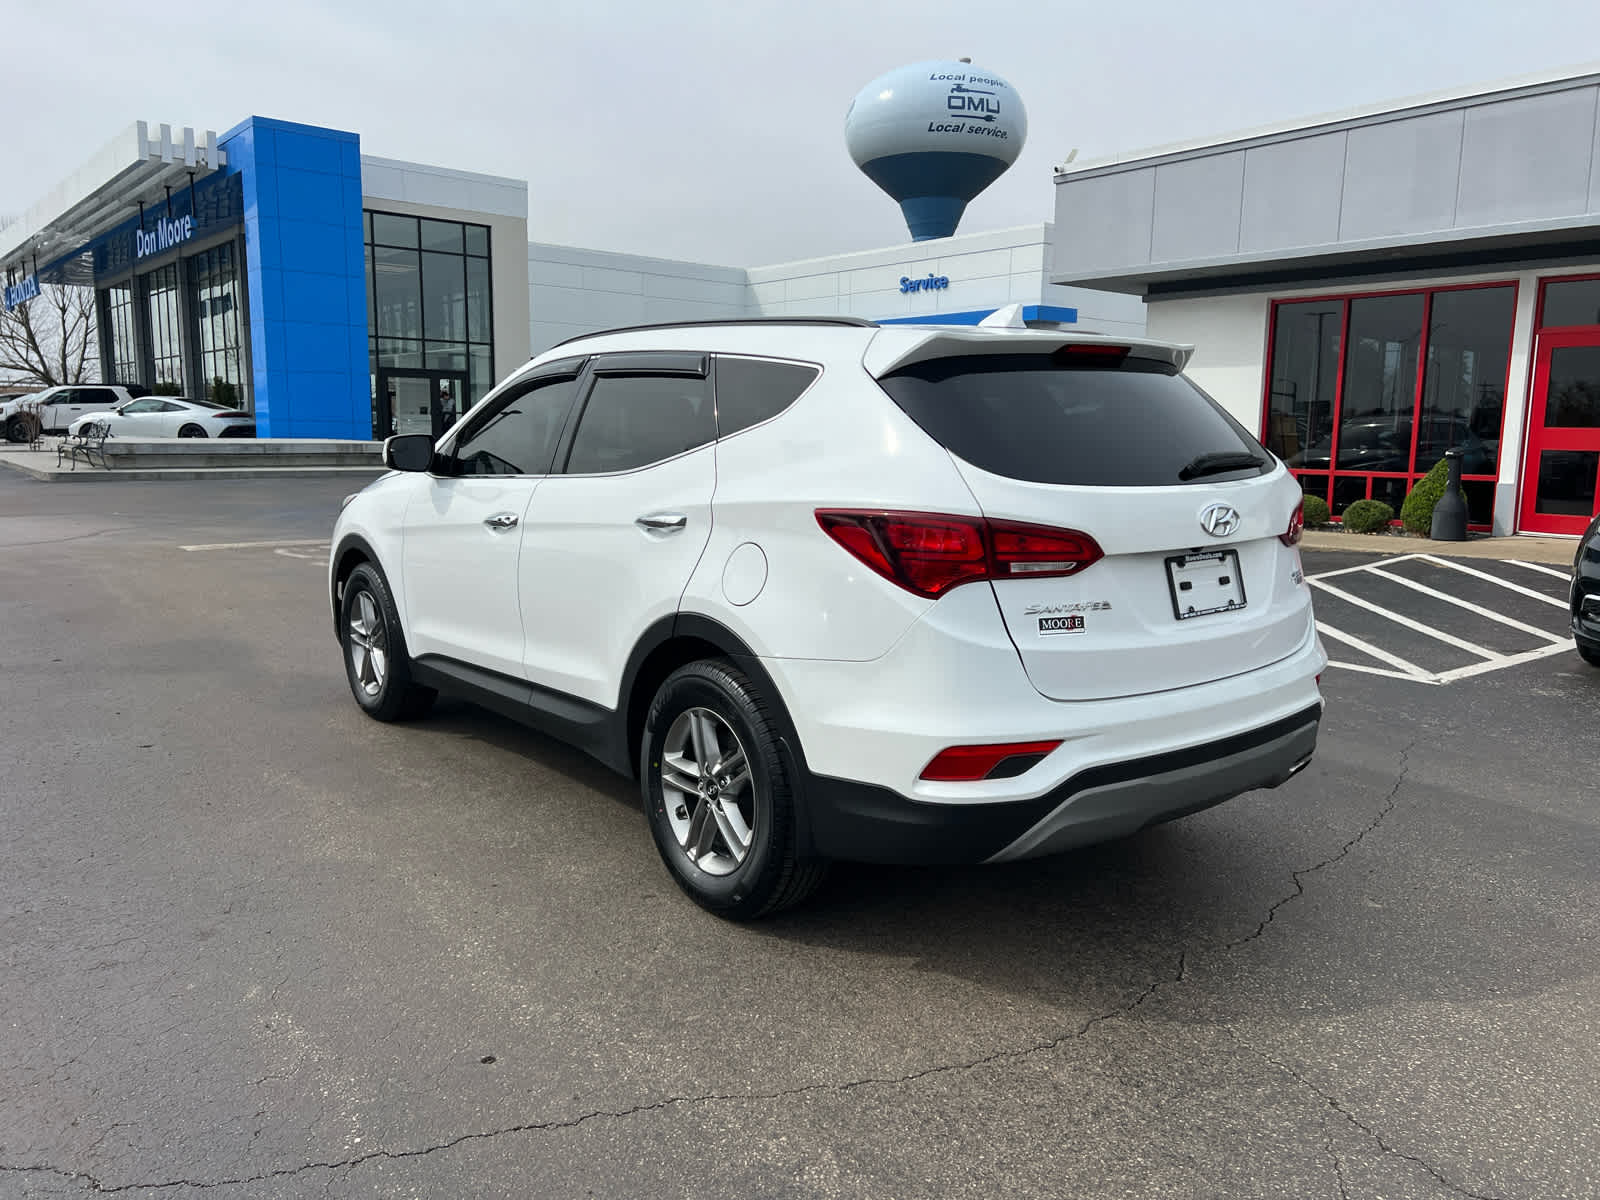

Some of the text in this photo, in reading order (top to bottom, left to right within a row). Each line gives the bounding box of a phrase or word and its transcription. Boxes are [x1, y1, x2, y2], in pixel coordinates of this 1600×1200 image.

[930, 73, 1007, 88] Local people.
[947, 95, 1000, 114] OMU
[928, 121, 1008, 139] Local service.
[136, 214, 192, 258] Don Moore
[10, 274, 37, 306] HONDA
[899, 273, 949, 293] Service
[1042, 618, 1082, 630] MOORE
